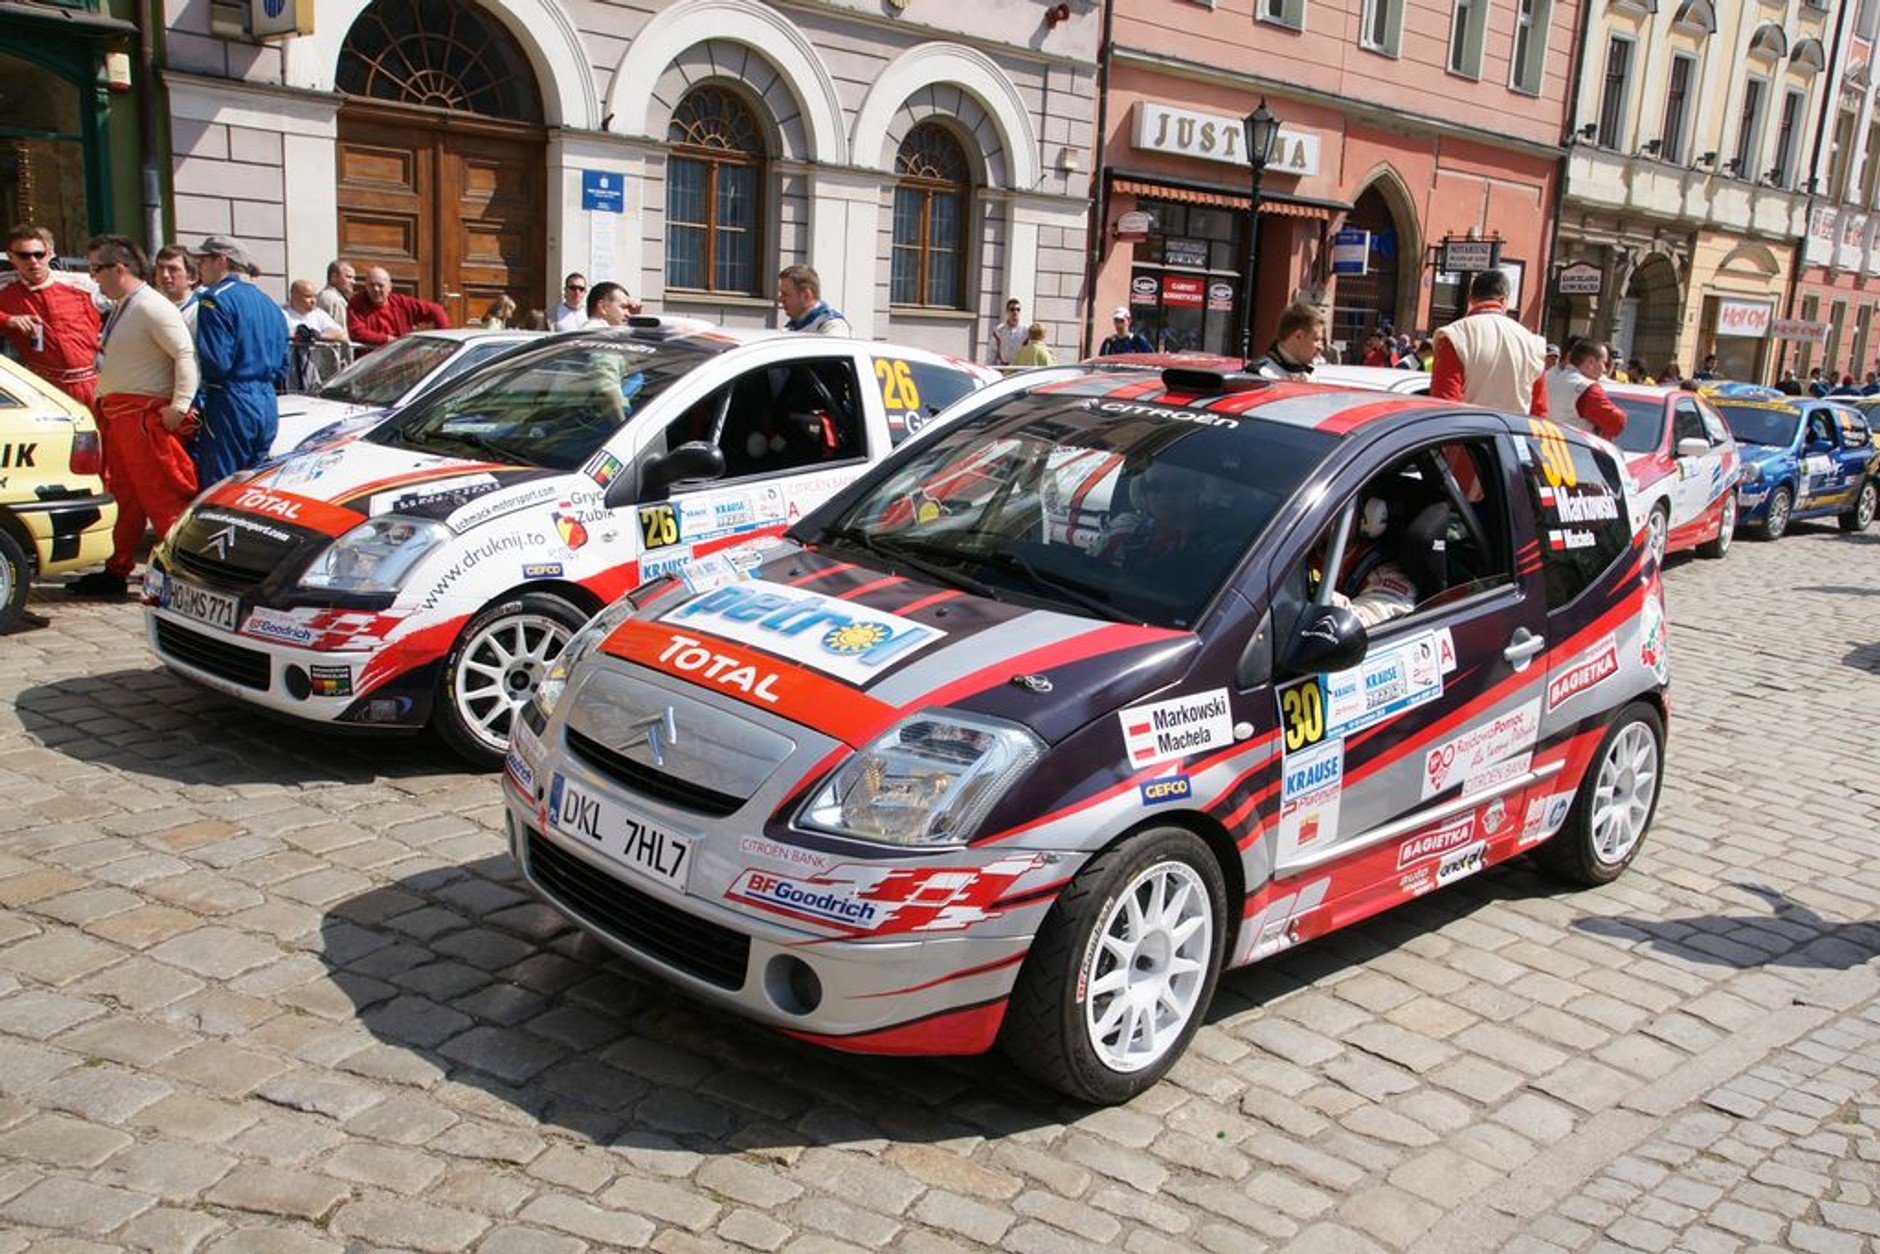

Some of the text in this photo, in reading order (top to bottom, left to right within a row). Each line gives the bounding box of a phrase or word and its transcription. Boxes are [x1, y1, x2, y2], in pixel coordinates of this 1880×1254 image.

[1154, 113, 1307, 169] JUSTNA
[874, 357, 920, 410] 26
[0, 443, 38, 468] IK
[235, 489, 303, 519] TOTAL
[788, 501, 800, 518] A
[640, 505, 679, 548] 26
[420, 530, 546, 611] www.druknij.to
[209, 596, 233, 627] 771
[657, 634, 780, 702] TOTAL
[1440, 638, 1454, 664] A
[1551, 653, 1615, 705] BAGIETKA
[1152, 695, 1227, 730] Markowski
[1283, 682, 1323, 750] 30
[1156, 727, 1211, 754] Machela
[1146, 779, 1188, 799] GEFCO
[1286, 755, 1339, 796] KRAUSE
[563, 780, 688, 879] DKL 7HL7
[1402, 824, 1469, 861] BAGIETKA
[791, 850, 827, 868] BANK
[747, 873, 877, 922] BFGoodrich
